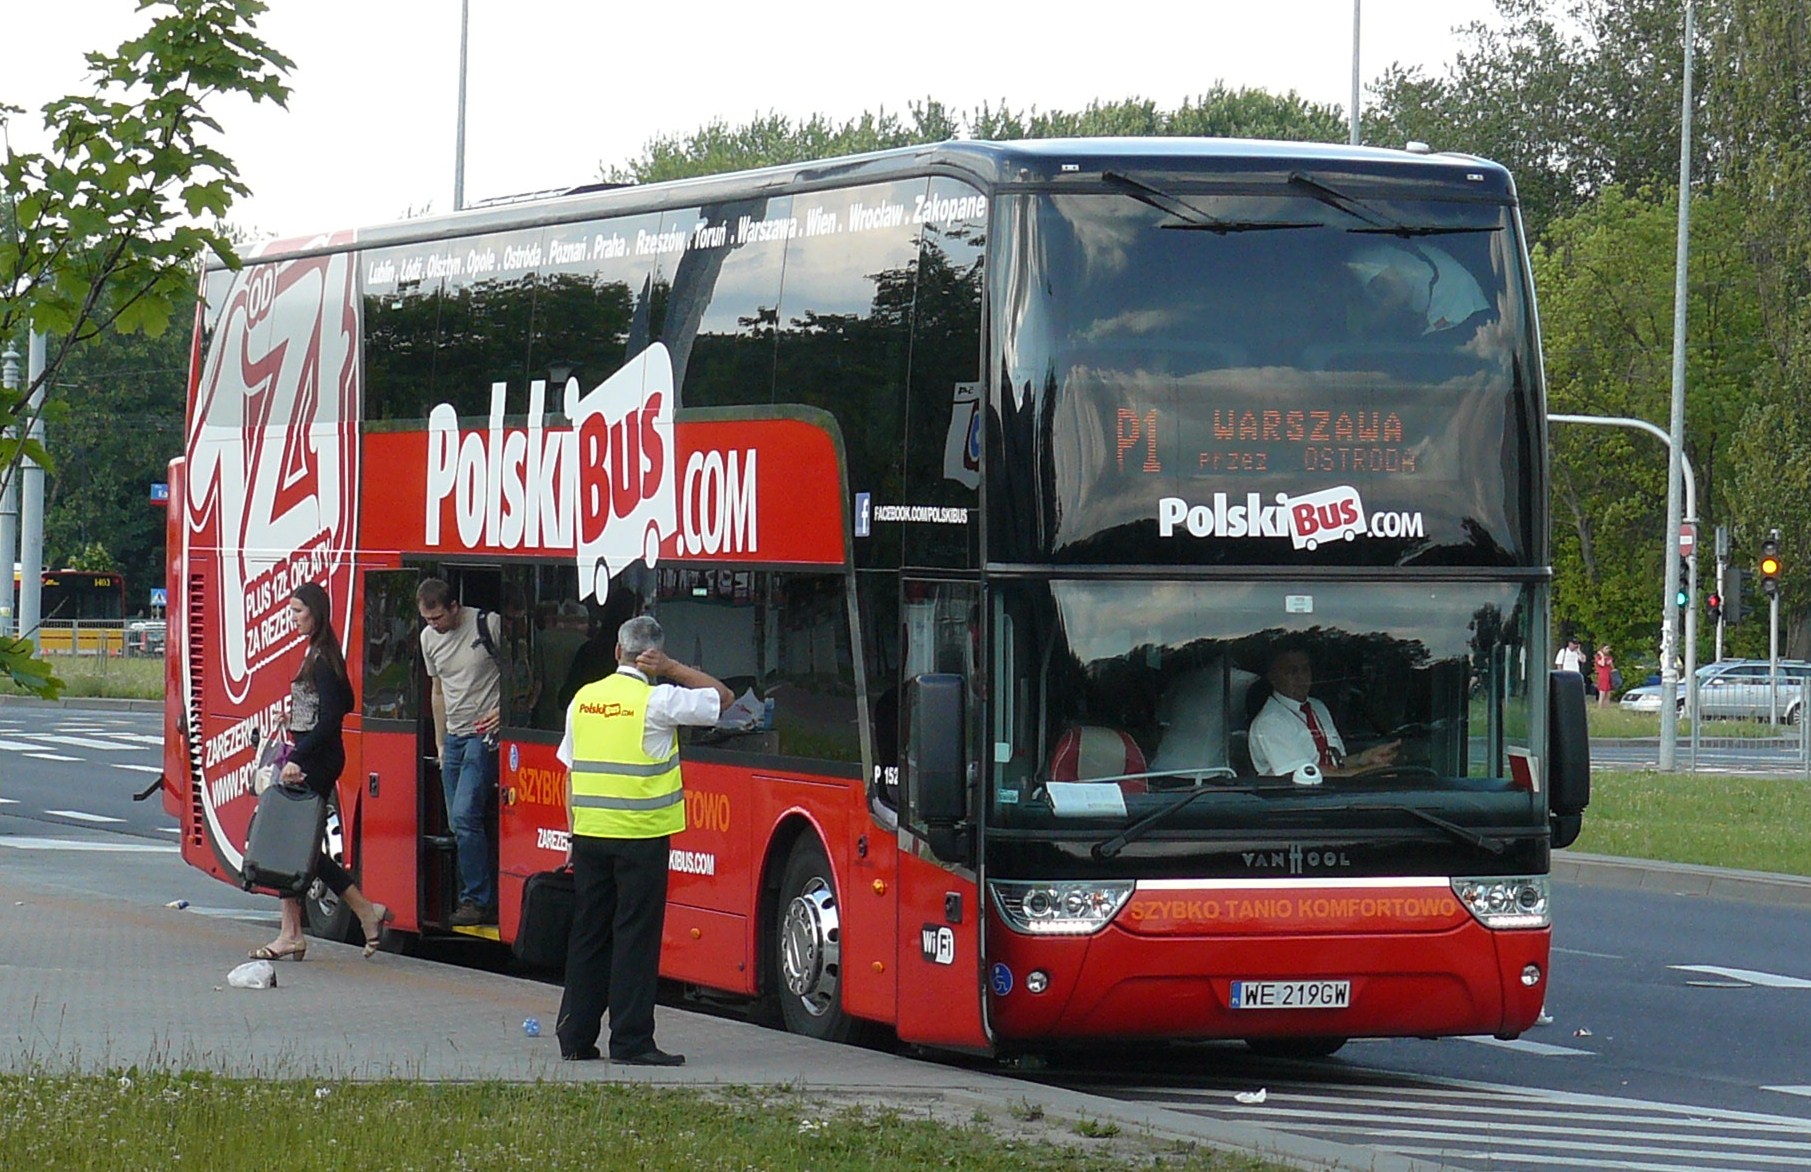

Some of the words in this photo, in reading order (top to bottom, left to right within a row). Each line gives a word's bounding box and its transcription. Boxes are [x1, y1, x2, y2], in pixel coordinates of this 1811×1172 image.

[368, 260, 395, 285] Lublin
[427, 253, 461, 282] Olsztyn
[467, 249, 496, 278] Opole
[503, 242, 541, 271] Ostróda
[549, 236, 587, 265] Poznań
[593, 232, 626, 260] Praha
[635, 222, 686, 255] Rzeszów
[694, 219, 727, 250] Toruń
[738, 215, 797, 244] Warszawa
[806, 205, 836, 237] Wien
[848, 199, 904, 232] Wrocław
[912, 193, 986, 228] Zakopane
[1117, 408, 1161, 473] P1
[1213, 409, 1402, 442] WARSZAWA
[246, 580, 272, 623] PLUS
[247, 625, 261, 660] ZA
[874, 764, 882, 784] P
[668, 848, 715, 877] KIBUS.COM
[1131, 900, 1220, 920] SZYBKO
[1226, 899, 1293, 920] TANIO
[1299, 897, 1457, 919] KOMFORTOWO
[1245, 984, 1276, 1007] WE
[1281, 983, 1348, 1006] 219GW
